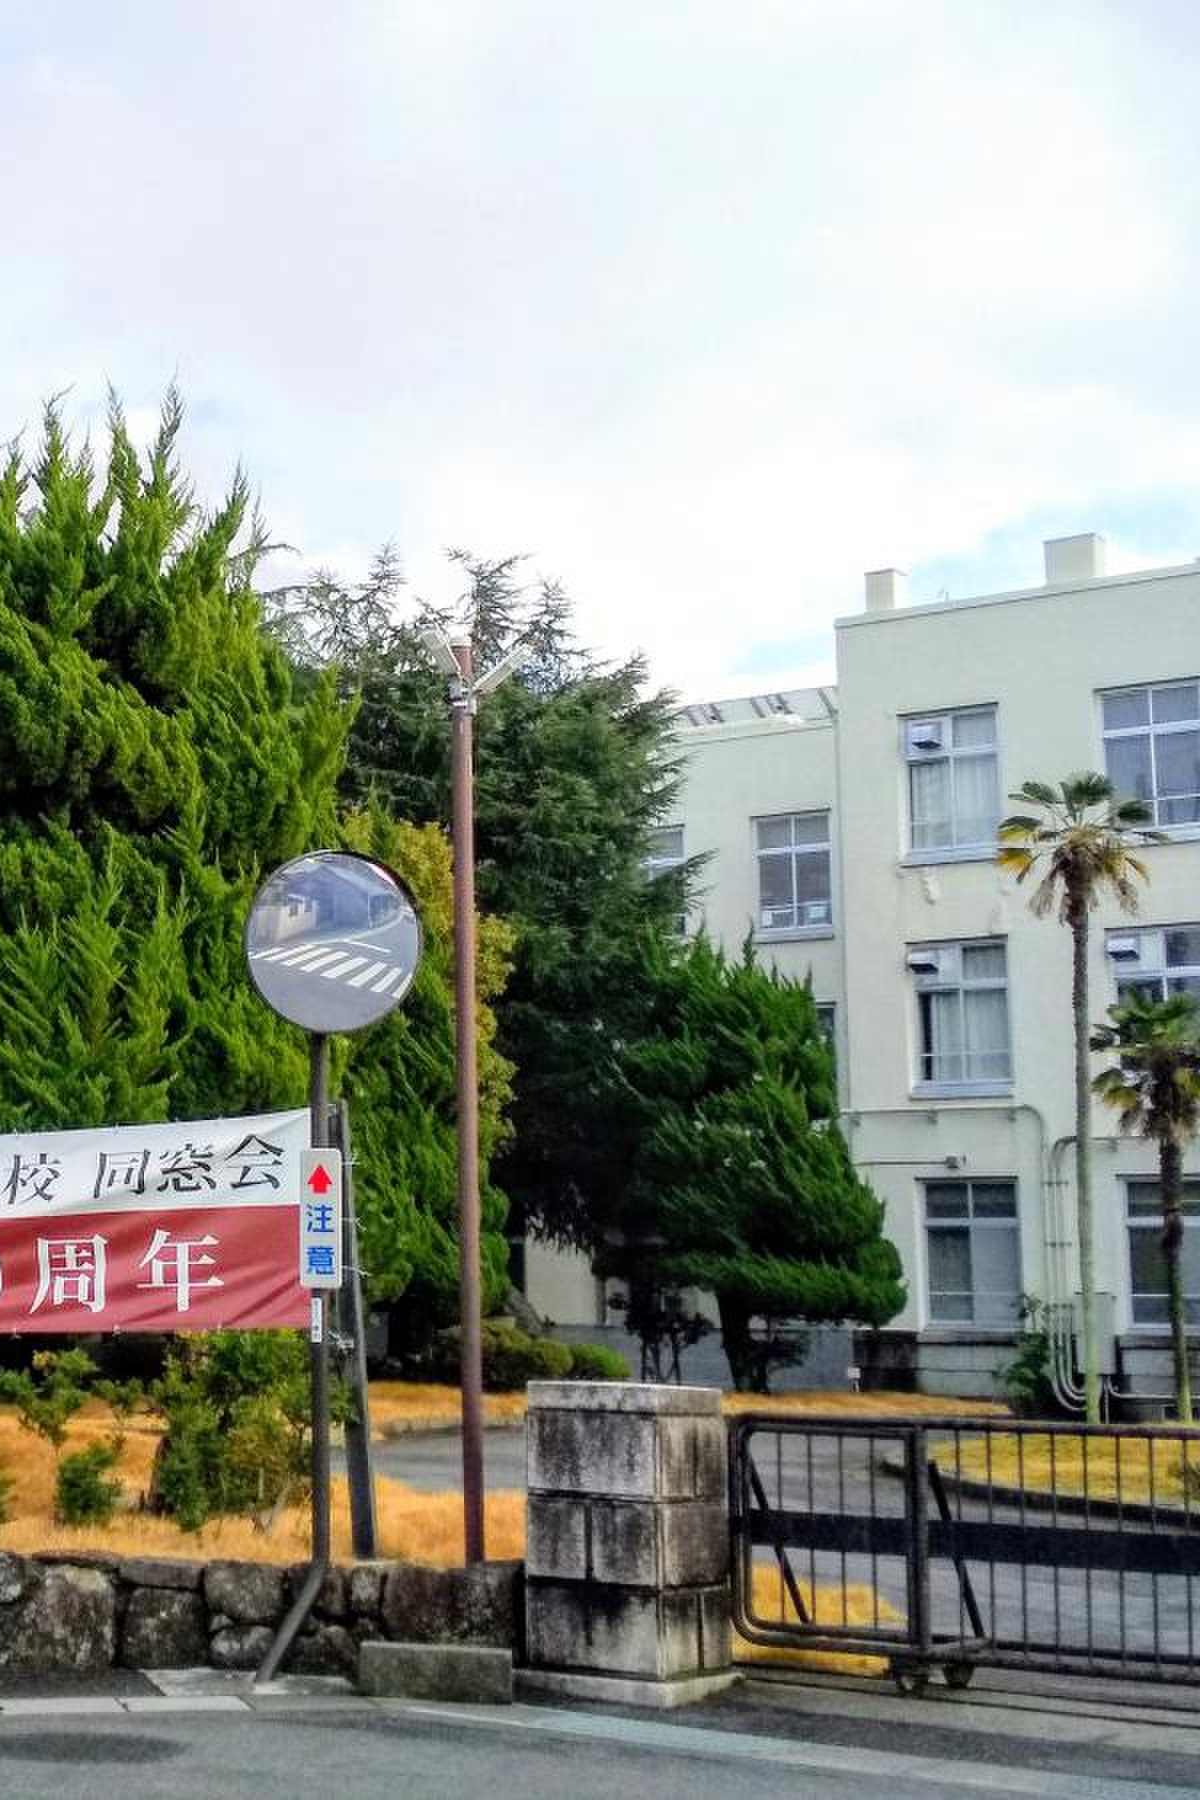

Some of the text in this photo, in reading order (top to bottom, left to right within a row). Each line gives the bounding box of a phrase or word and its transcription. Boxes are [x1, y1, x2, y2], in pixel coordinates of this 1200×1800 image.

[93, 1134, 284, 1200] 同窓会
[306, 1204, 335, 1276] 注意
